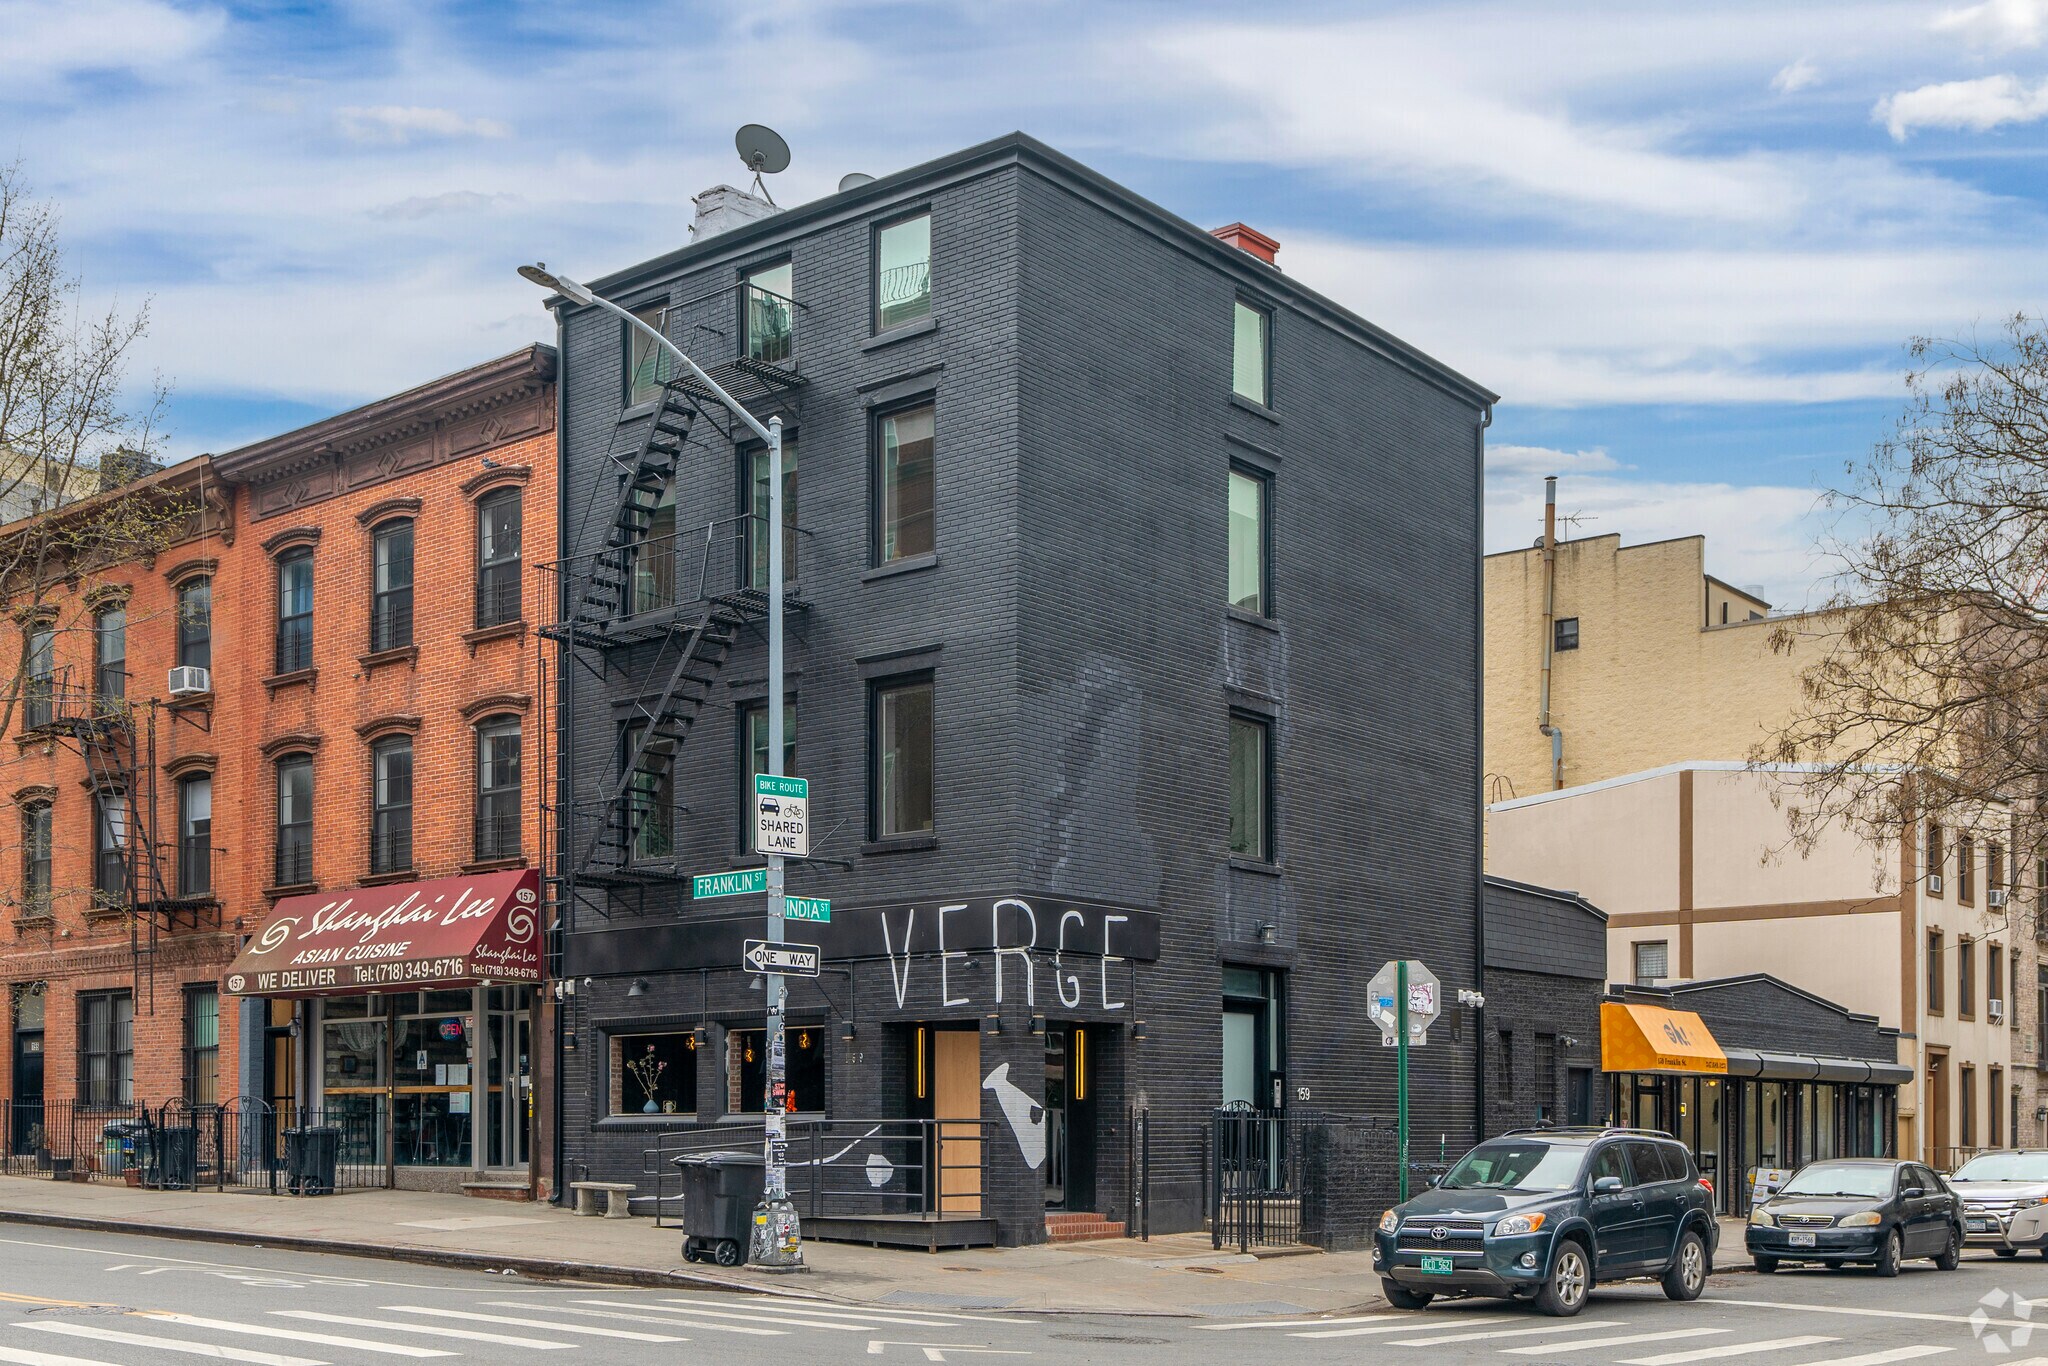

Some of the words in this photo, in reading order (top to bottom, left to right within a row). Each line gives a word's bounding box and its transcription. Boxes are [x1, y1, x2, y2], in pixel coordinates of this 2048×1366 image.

[760, 780, 776, 791] BIKE
[779, 782, 803, 794] ROUTE
[760, 819, 804, 834] SHARED
[767, 835, 796, 849] LANE
[697, 874, 753, 895] FRANKLIN
[754, 871, 763, 882] ST
[519, 892, 534, 901] 157
[298, 890, 444, 942] Shanghai
[441, 887, 496, 927] Lee
[786, 900, 820, 919] INDIA
[820, 903, 829, 912] ST
[290, 946, 344, 965] ASIAN
[345, 941, 412, 961] CUISINE
[475, 944, 522, 964] Shanghai
[522, 948, 538, 963] Lee
[754, 950, 777, 964] ONE
[789, 953, 813, 966] WAY
[881, 899, 1129, 1010] VERGE
[405, 958, 463, 979] 349-6716
[504, 966, 538, 979] 349-6716
[230, 978, 243, 989] 157
[257, 973, 278, 989] WE
[281, 968, 336, 988] DELIVER
[440, 1024, 462, 1035] OPEN
[1296, 1087, 1310, 1101] 159
